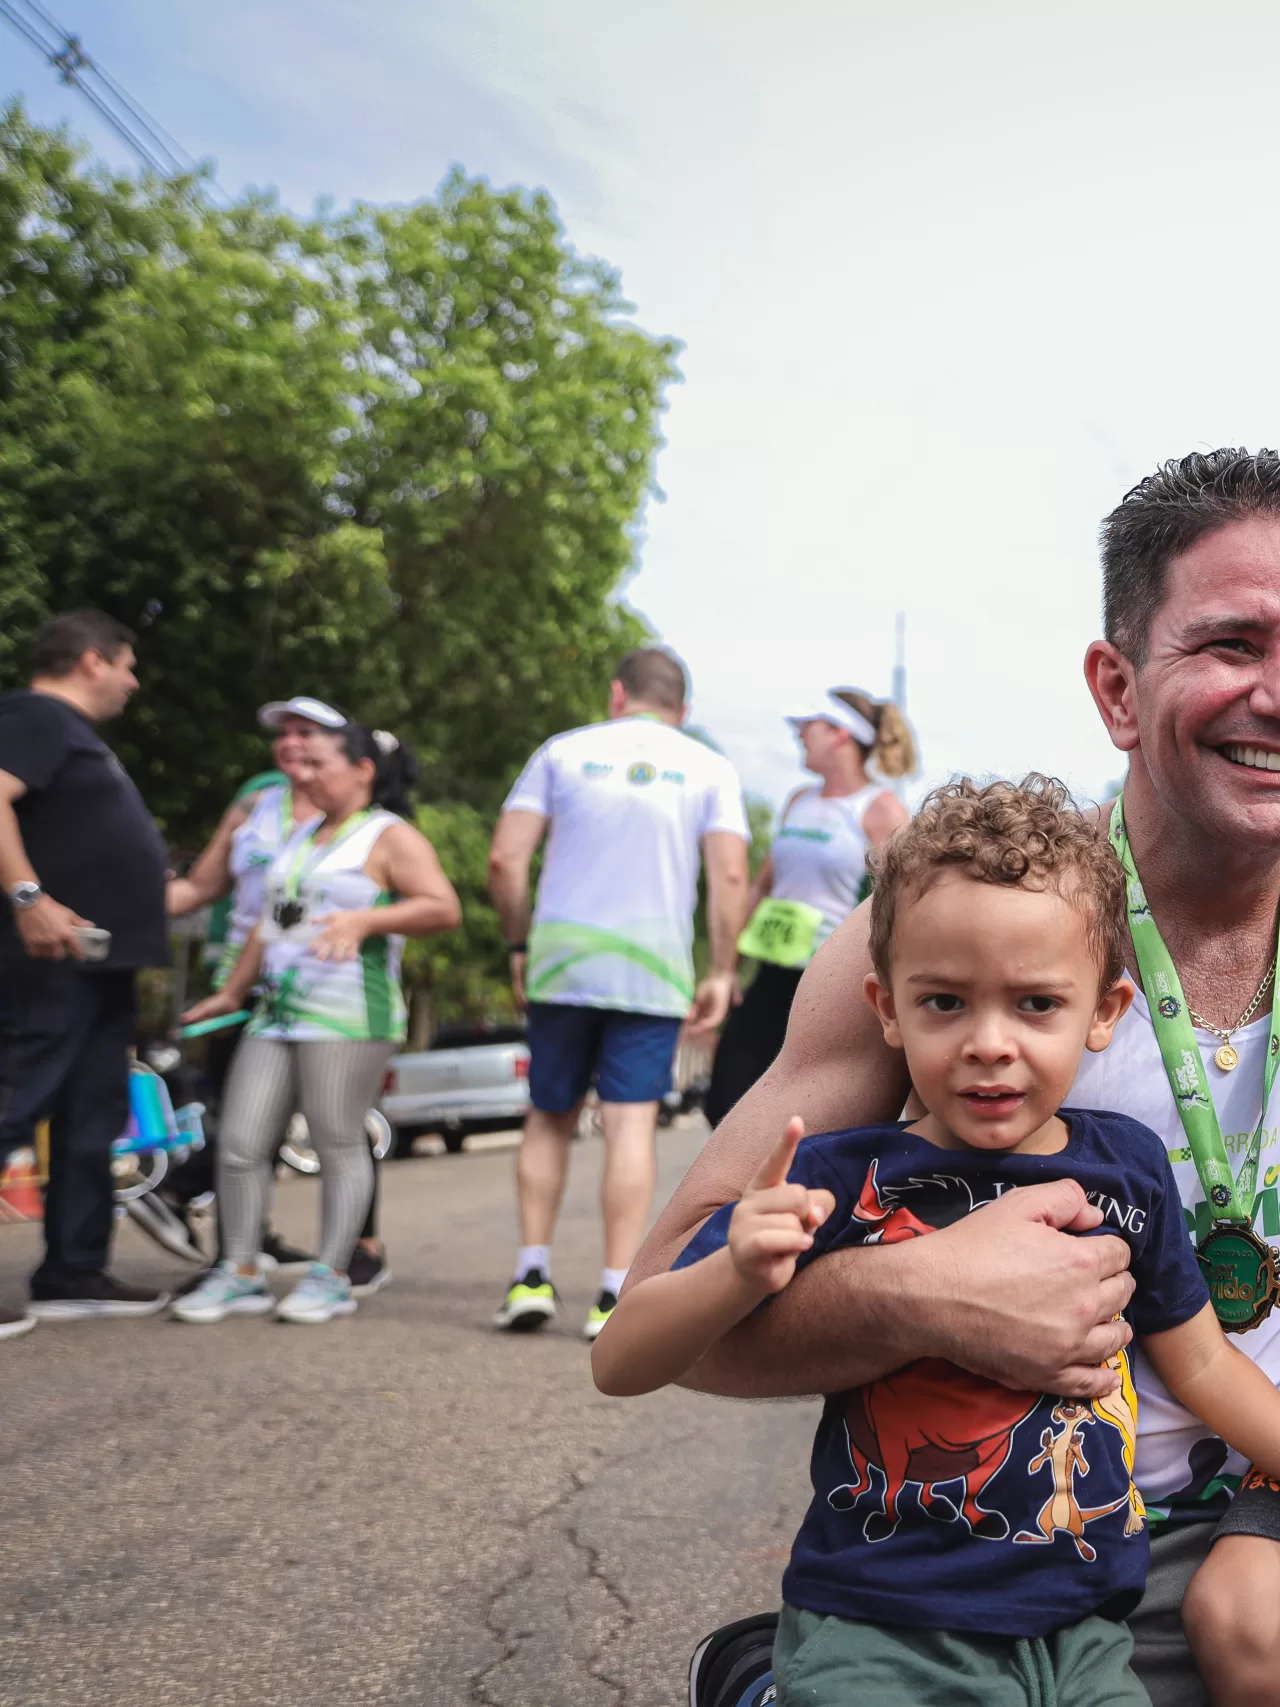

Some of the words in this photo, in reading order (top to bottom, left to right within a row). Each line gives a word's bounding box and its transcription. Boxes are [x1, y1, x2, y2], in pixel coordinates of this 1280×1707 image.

[1157, 971, 1170, 993] ACRE
[1175, 1067, 1190, 1091] ser
[1180, 1048, 1200, 1090] vidor
[1097, 1193, 1147, 1233] ING
